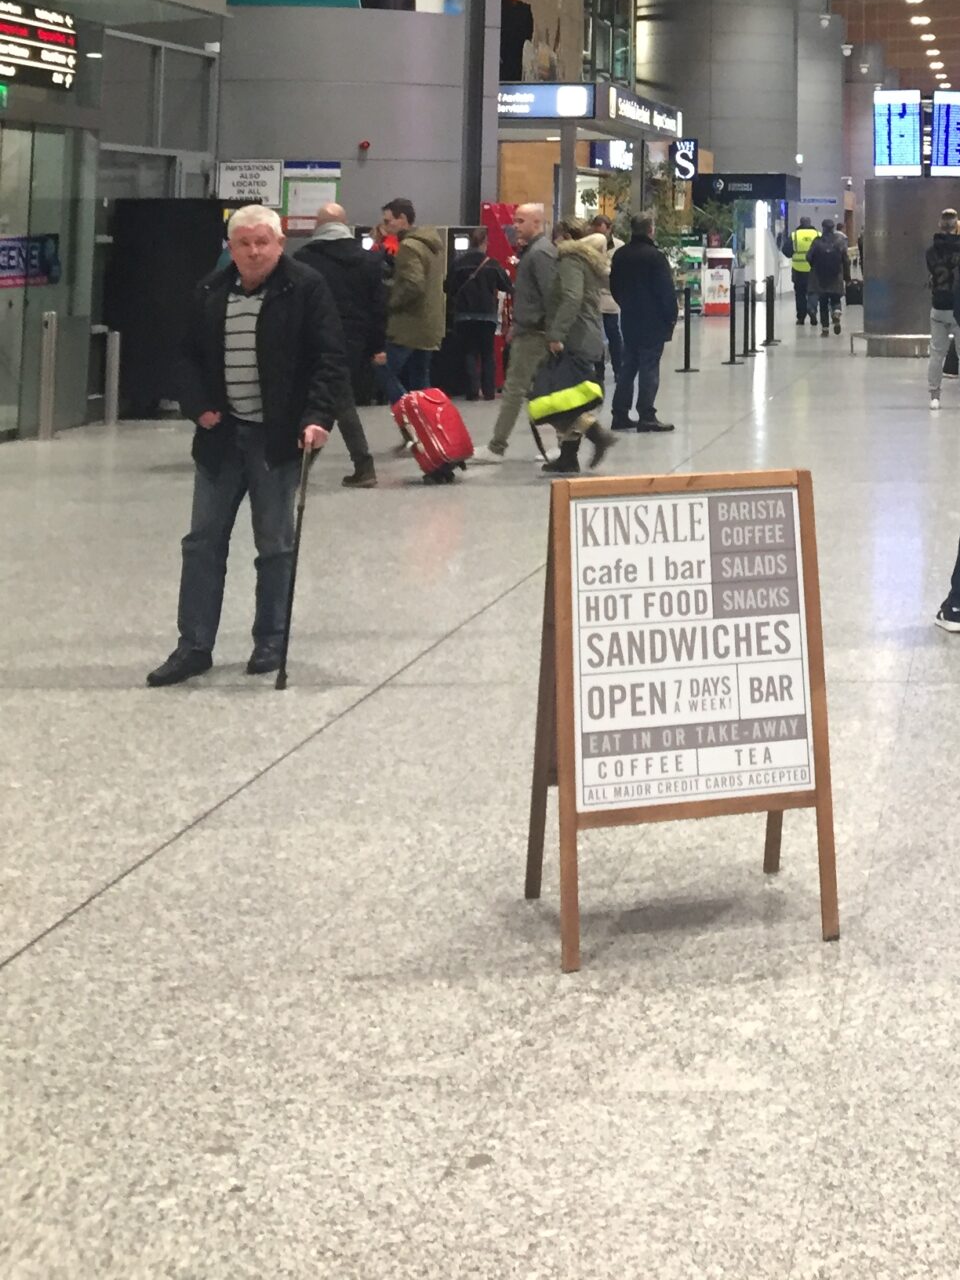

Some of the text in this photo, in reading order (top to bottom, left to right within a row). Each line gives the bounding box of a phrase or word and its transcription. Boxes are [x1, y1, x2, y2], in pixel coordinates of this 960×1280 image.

[581, 502, 705, 547] KINSALE
[718, 500, 786, 520] BARISTA
[721, 524, 785, 546] COFFEE
[582, 558, 638, 585] cafe
[665, 556, 706, 580] bar
[721, 554, 788, 578] SALADS
[585, 589, 708, 622] HOT FOOD
[723, 587, 790, 611] SNACKS
[587, 620, 791, 668] SANDWICHES
[587, 676, 731, 720] OPEN 7 DAYS
[749, 674, 794, 704] BAR
[674, 698, 733, 713] A WEEK!
[590, 719, 799, 754] EAT IN OR TAKE-AWAY
[598, 754, 684, 779] COFFEE
[735, 747, 773, 766] TEA
[587, 768, 808, 801] ALL MAJOR CREDIT CARDS ACCEPTED
